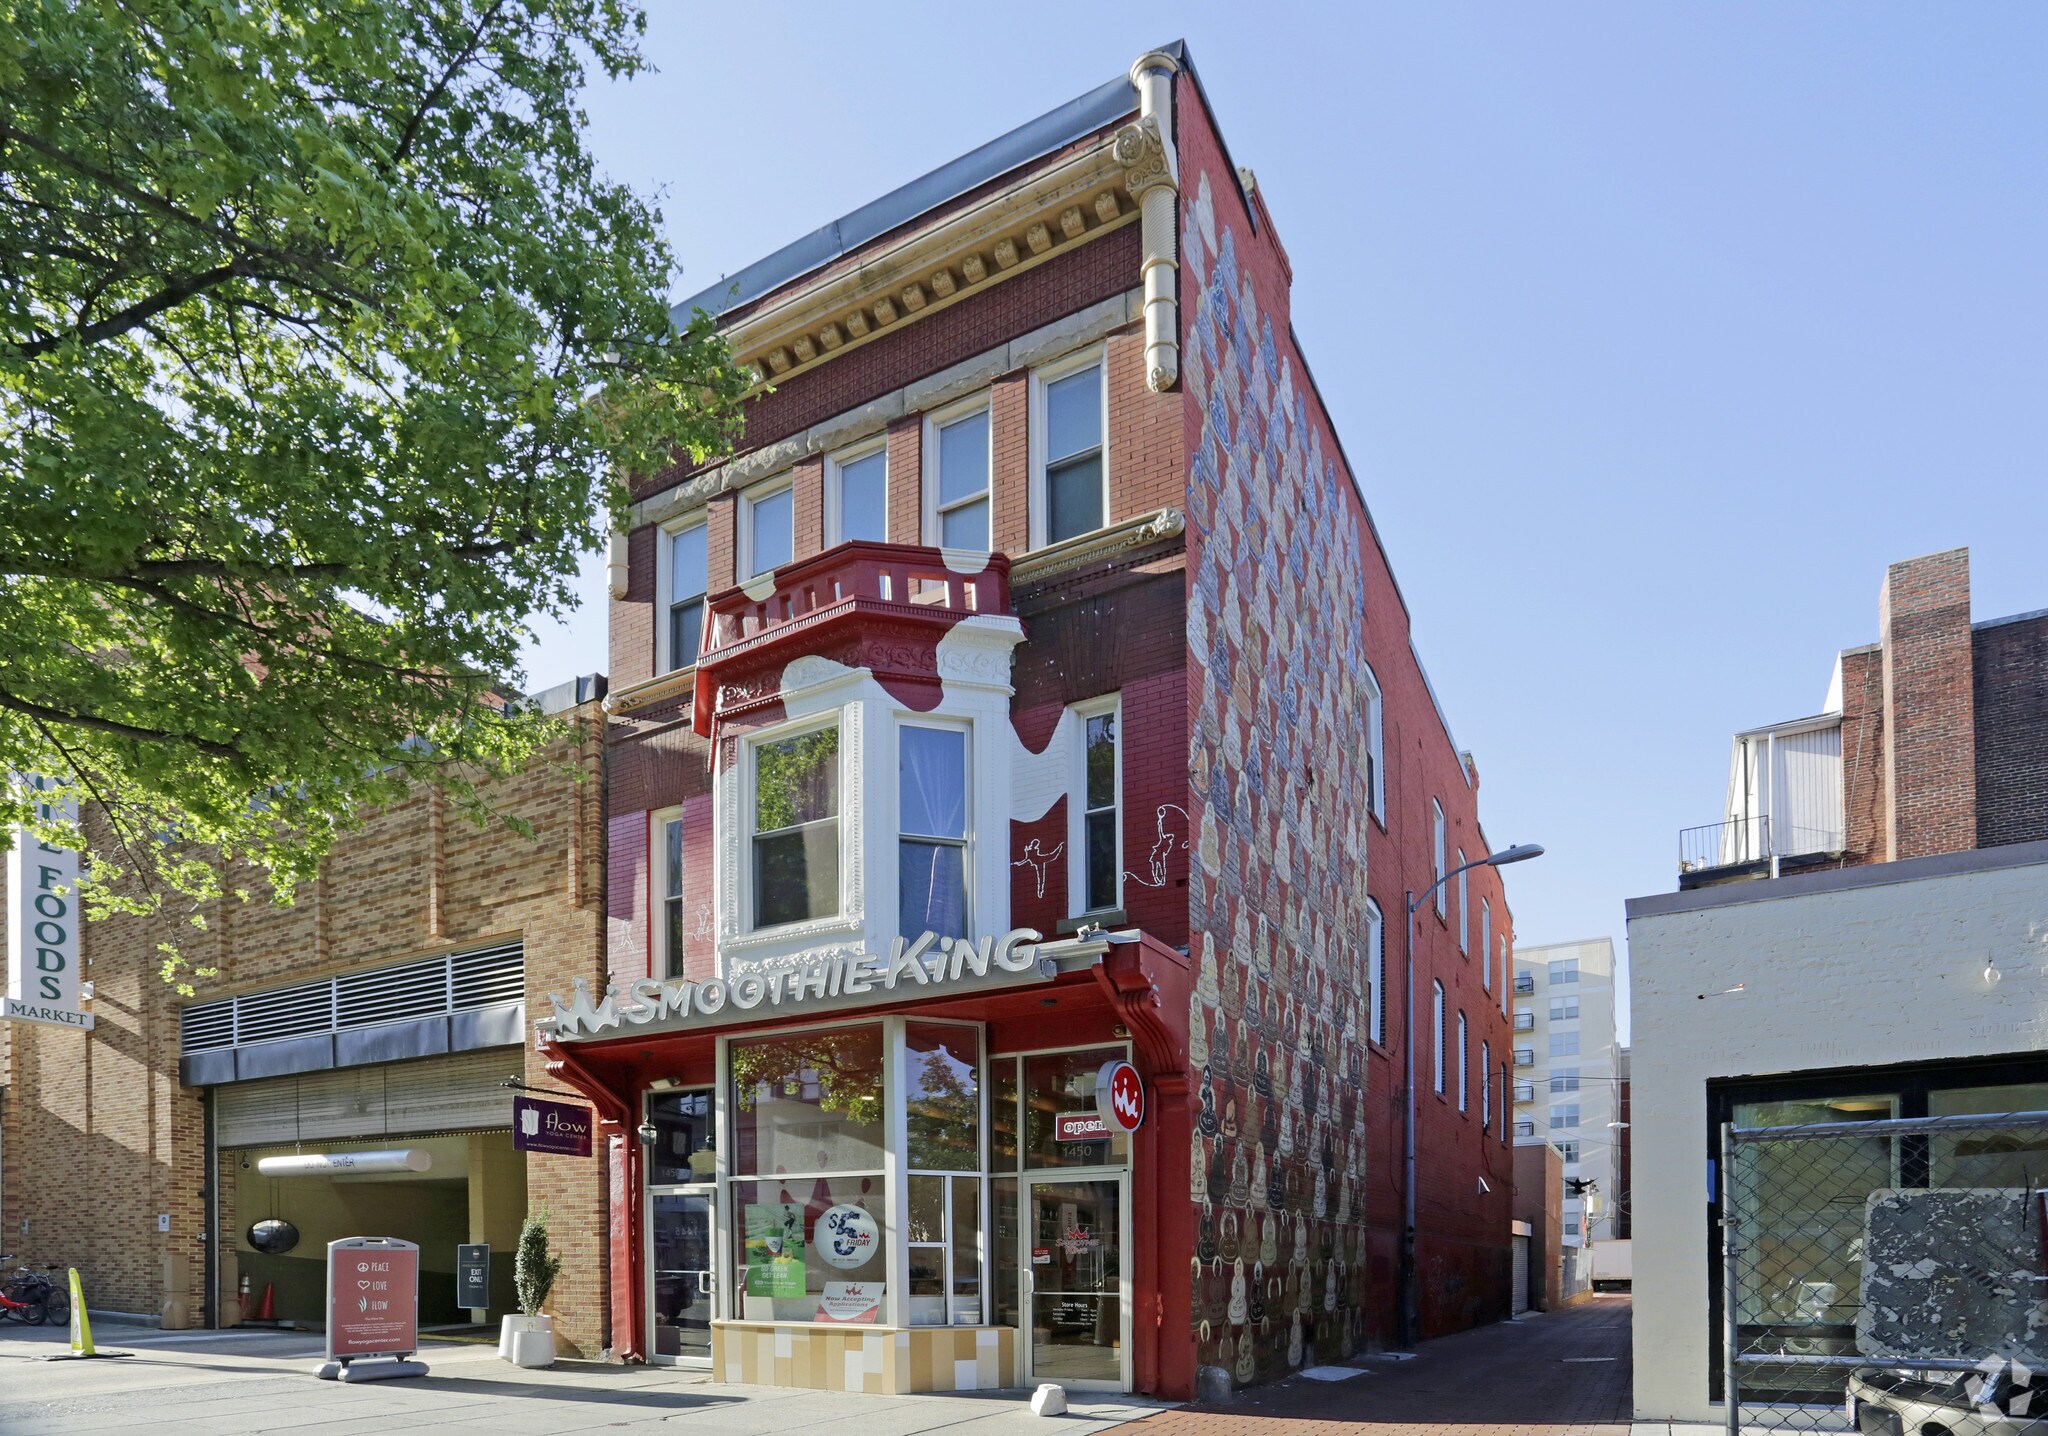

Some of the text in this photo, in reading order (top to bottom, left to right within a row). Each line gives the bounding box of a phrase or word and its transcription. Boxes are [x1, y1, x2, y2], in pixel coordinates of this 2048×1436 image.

[34, 864, 68, 1000] FOODS
[626, 952, 881, 1025] SMOOTHIE
[10, 1002, 88, 1025] MARKET
[545, 1109, 587, 1133] flow
[1063, 1120, 1107, 1134] open
[1062, 1145, 1092, 1157] 1450
[333, 1158, 355, 1168] ENTER
[846, 1238, 871, 1247] FRIDAY
[371, 1262, 389, 1272] PEACE
[373, 1281, 387, 1290] LOVE
[347, 1337, 401, 1346] flowyogacenter.com
